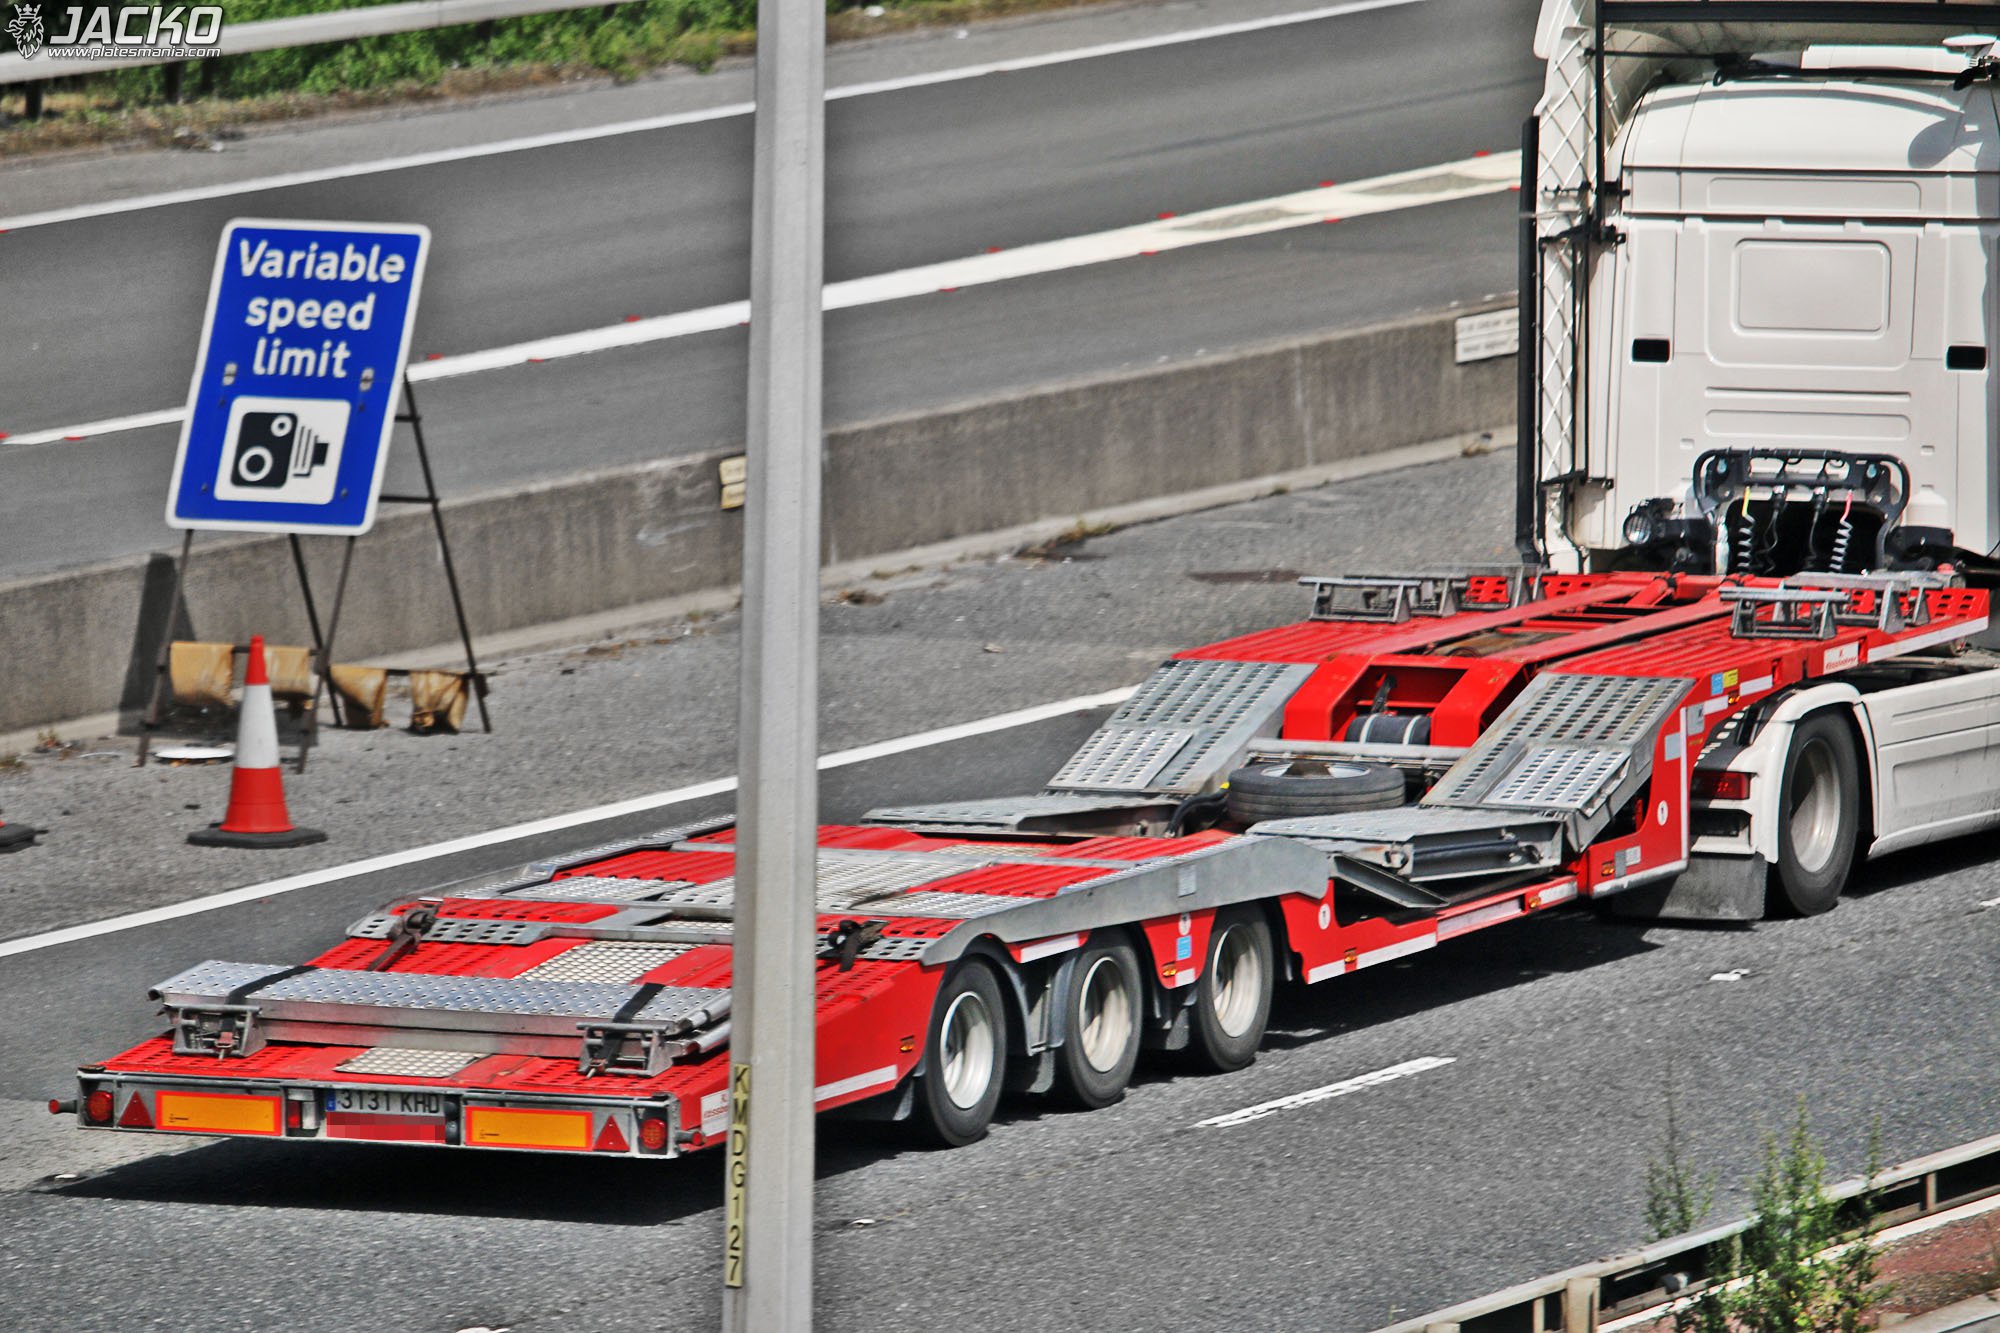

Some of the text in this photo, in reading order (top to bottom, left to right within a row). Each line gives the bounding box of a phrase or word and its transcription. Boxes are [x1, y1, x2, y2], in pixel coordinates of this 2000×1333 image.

[239, 238, 406, 283] Variable
[245, 292, 376, 333] speed
[252, 337, 351, 378] limit
[341, 1089, 390, 1111] 3131
